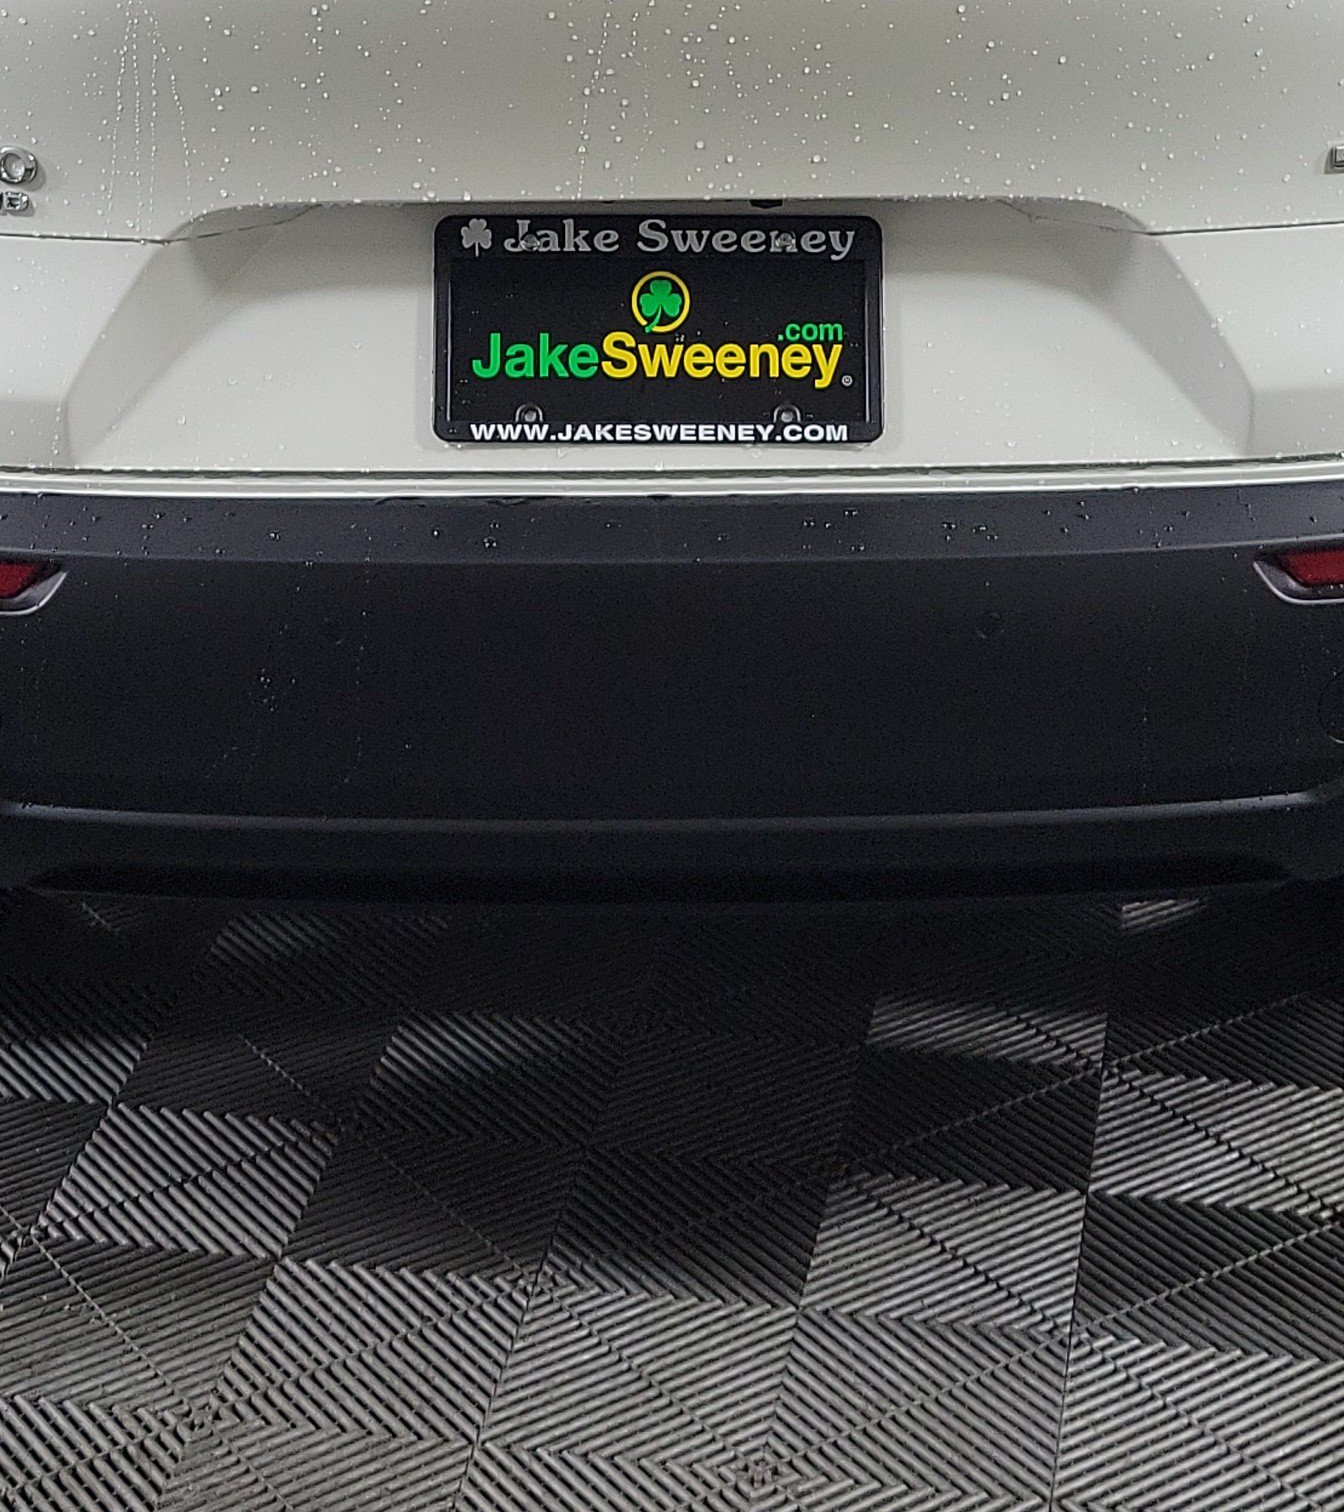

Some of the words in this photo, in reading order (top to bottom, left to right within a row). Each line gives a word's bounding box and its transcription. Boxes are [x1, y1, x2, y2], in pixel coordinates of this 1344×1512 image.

[504, 218, 620, 254] Jake
[637, 218, 855, 261] Sweeney
[777, 322, 844, 342] .com
[471, 331, 844, 389] JakeSweeney
[470, 423, 849, 443] WWW.JAKESWEENEY.COM
